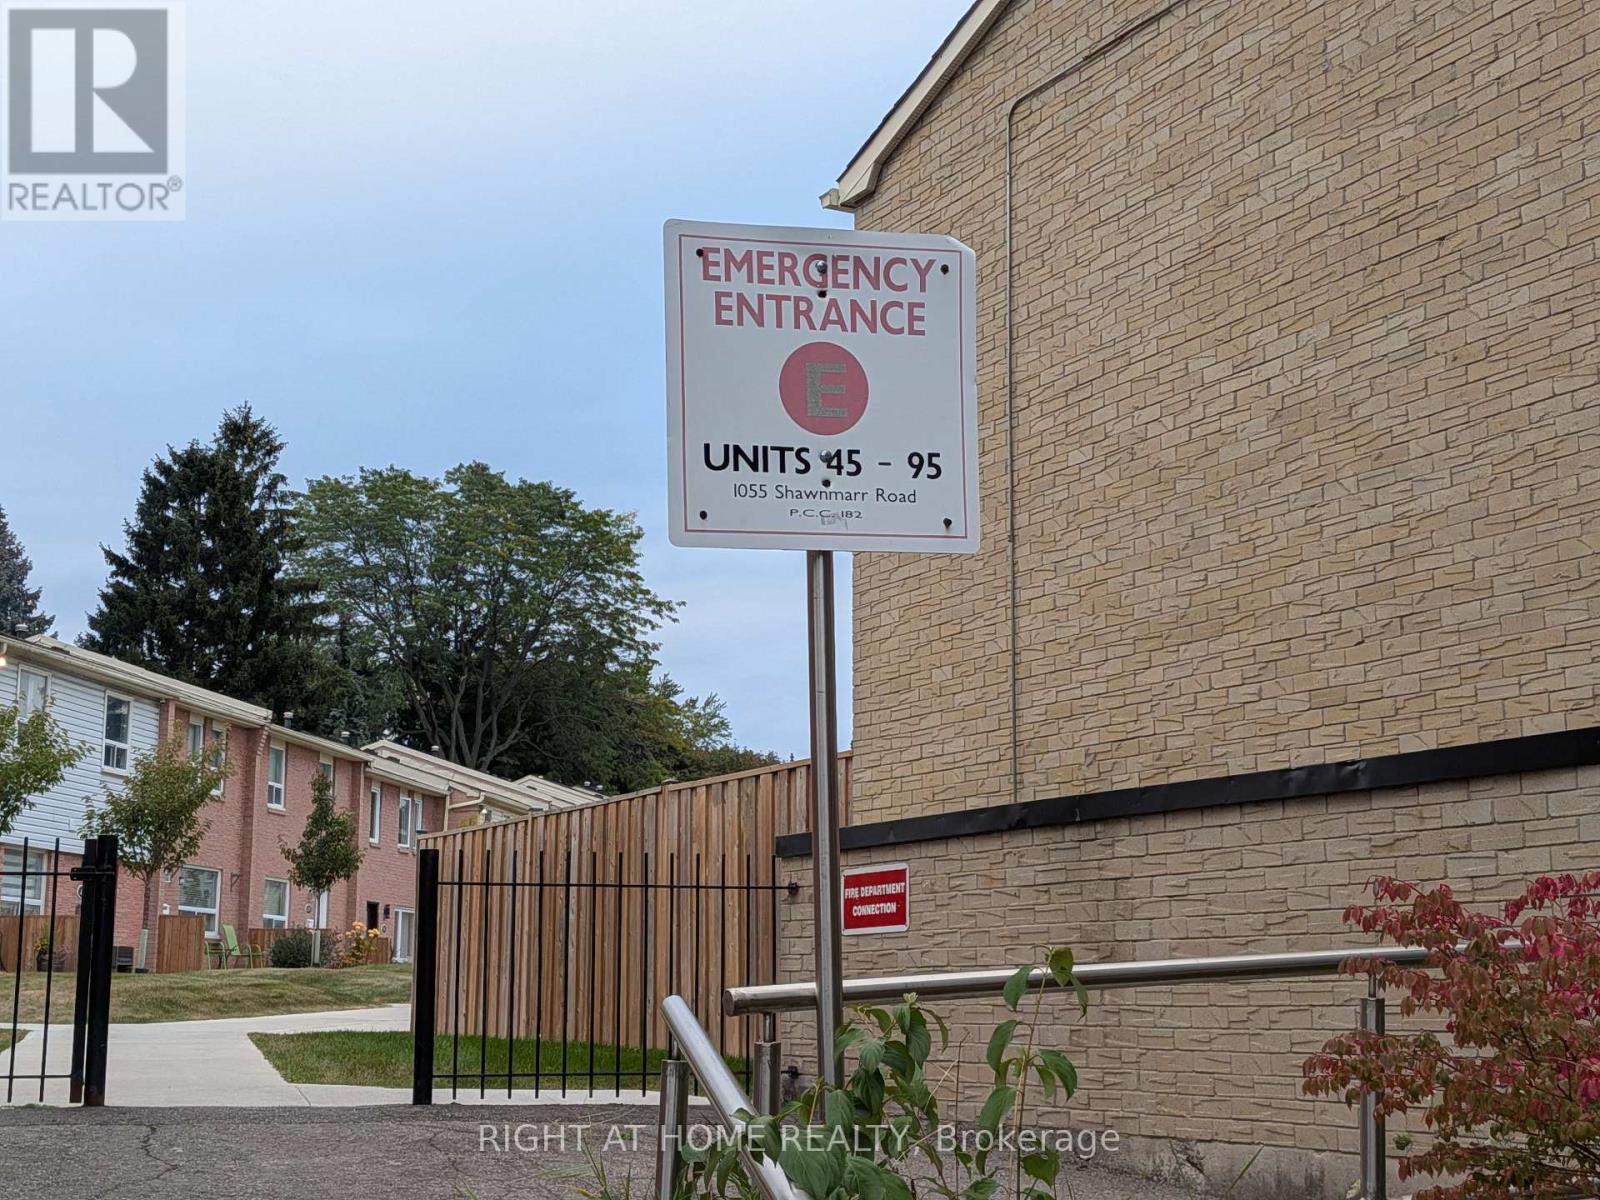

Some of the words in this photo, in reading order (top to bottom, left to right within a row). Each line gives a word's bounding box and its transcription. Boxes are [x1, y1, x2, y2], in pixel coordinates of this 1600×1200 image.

[701, 246, 937, 293] EMERGENCY
[714, 291, 926, 337] ENTRANCE
[805, 362, 848, 418] E
[703, 442, 811, 475] UNITS
[826, 448, 862, 477] 45
[907, 451, 942, 480] 95
[733, 483, 768, 500] 1055
[775, 484, 869, 502] Shawnmarr
[875, 487, 917, 504] Road
[840, 510, 863, 519] 182
[844, 887, 860, 900] FIRE
[860, 882, 905, 898] DEPARTMENT
[852, 902, 897, 917] CONNECTION
